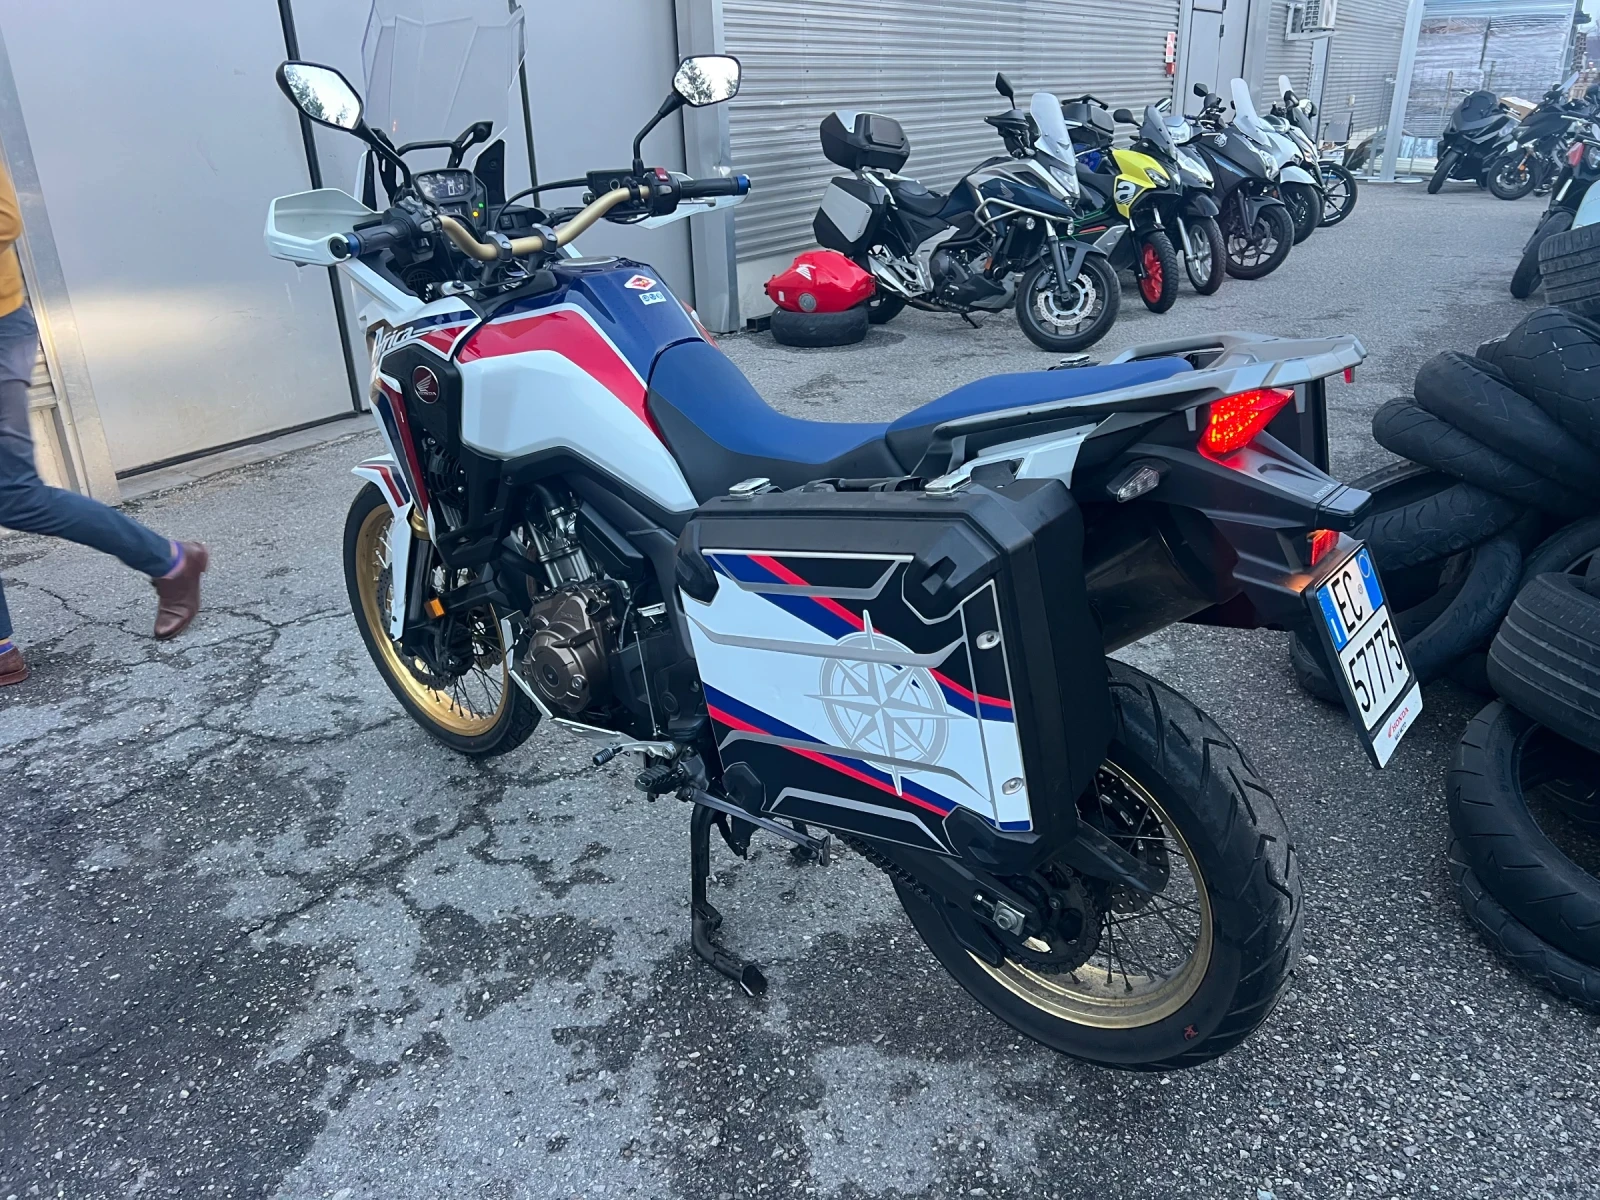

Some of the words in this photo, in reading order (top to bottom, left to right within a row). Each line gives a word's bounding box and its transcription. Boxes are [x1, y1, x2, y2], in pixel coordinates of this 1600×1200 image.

[1312, 483, 1335, 499] HONDA
[1331, 570, 1363, 634] EC
[1348, 618, 1403, 712] 57773
[1392, 707, 1409, 733] HONDA
